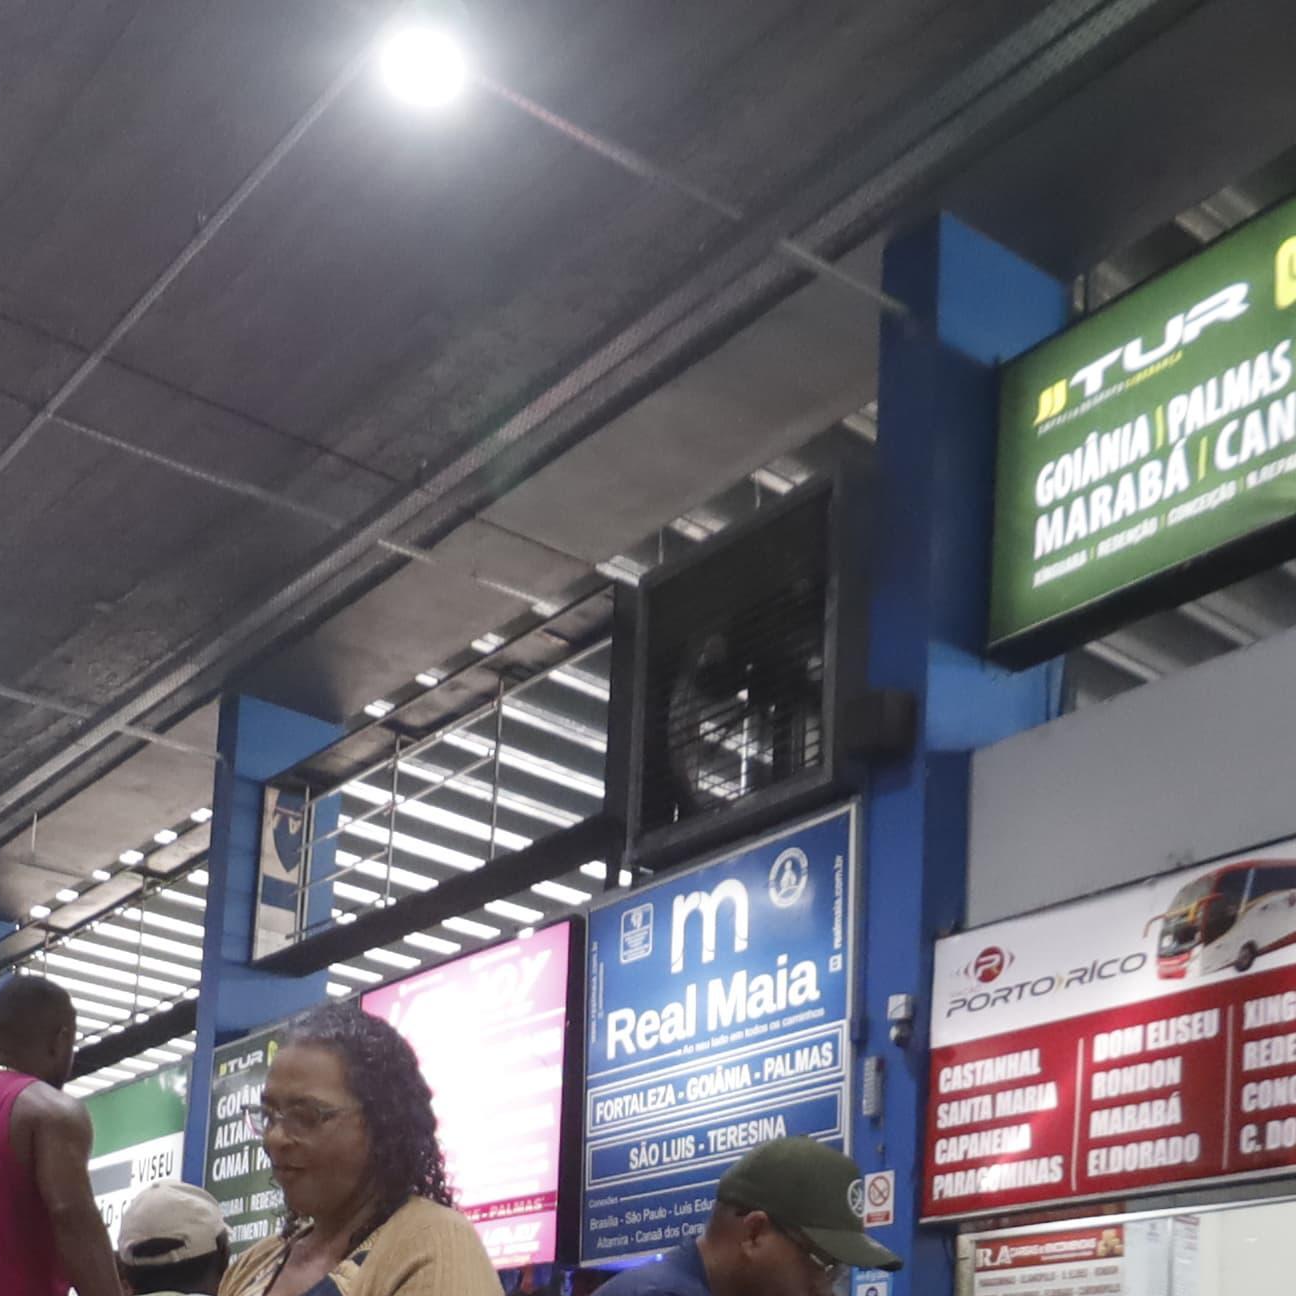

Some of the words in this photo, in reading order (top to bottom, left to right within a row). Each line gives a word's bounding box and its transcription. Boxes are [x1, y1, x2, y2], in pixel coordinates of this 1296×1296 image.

[1036, 414, 1151, 507] GOIÂNIA
[1167, 338, 1292, 445] PALMAS
[1034, 437, 1190, 560] MARABÁ
[607, 983, 698, 1060] Real
[707, 953, 821, 1032] Maia
[946, 976, 1056, 1018] PORTO
[1064, 952, 1147, 989] RICO
[1092, 1024, 1144, 1063] DOM
[1146, 1008, 1220, 1050] ELISEU
[595, 1084, 675, 1123] FORTALEZA
[686, 1066, 752, 1102] GOIÂNIA
[764, 1042, 834, 1082] PALMAS
[939, 1047, 1041, 1094] CASTANHAL
[1091, 1056, 1182, 1101] RONDON
[936, 1094, 993, 1130] SANTA
[995, 1081, 1059, 1118] MARIA
[1089, 1091, 1182, 1139] MARABÁ
[629, 1142, 660, 1170] SÃO
[662, 1135, 696, 1163] LUIS
[707, 1115, 787, 1152] TERESINA
[934, 1122, 1032, 1165] CAPANEMA
[1087, 1133, 1200, 1178] ELDORADO
[1240, 1124, 1262, 1154] C.
[138, 1149, 174, 1182] VISEU
[212, 1145, 249, 1182] CANAÃ
[932, 1155, 1064, 1201] PARAGOMINAS
[642, 1206, 667, 1221] Paulo
